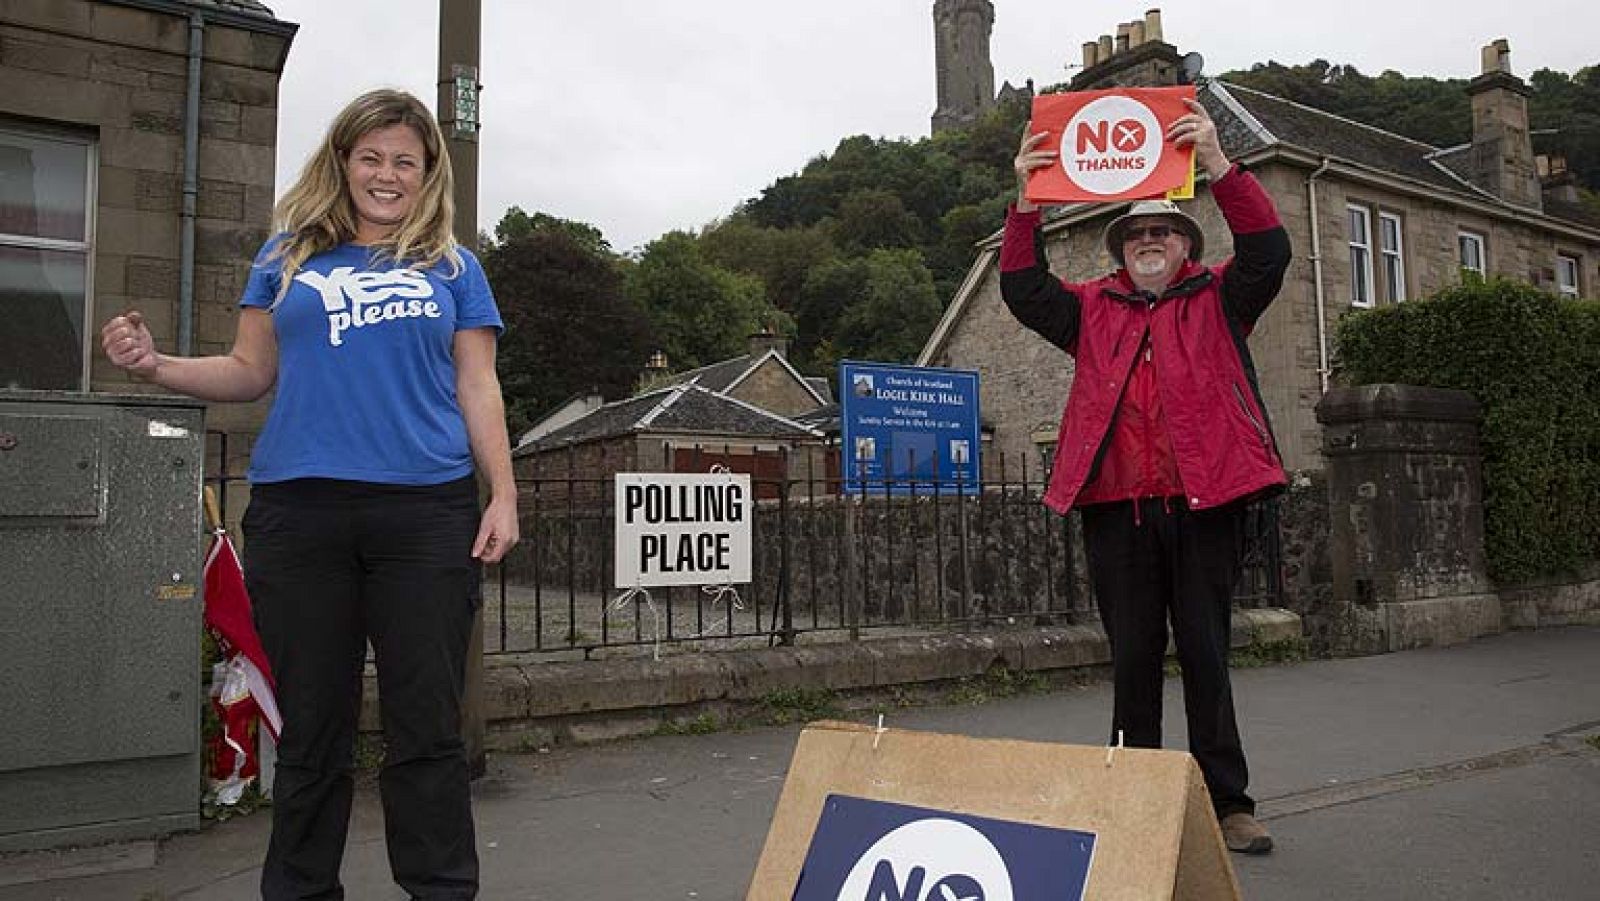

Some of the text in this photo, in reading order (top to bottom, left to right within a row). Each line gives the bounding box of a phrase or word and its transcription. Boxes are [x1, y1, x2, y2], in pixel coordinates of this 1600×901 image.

[1077, 120, 1147, 154] NO
[1075, 157, 1146, 172] THANKS
[328, 299, 442, 347] please
[876, 388, 965, 406] LOGIE KIRK HALL
[886, 376, 913, 387] Church
[914, 377, 922, 387] of
[626, 483, 743, 524] POLLING
[641, 533, 730, 573] PLACE
